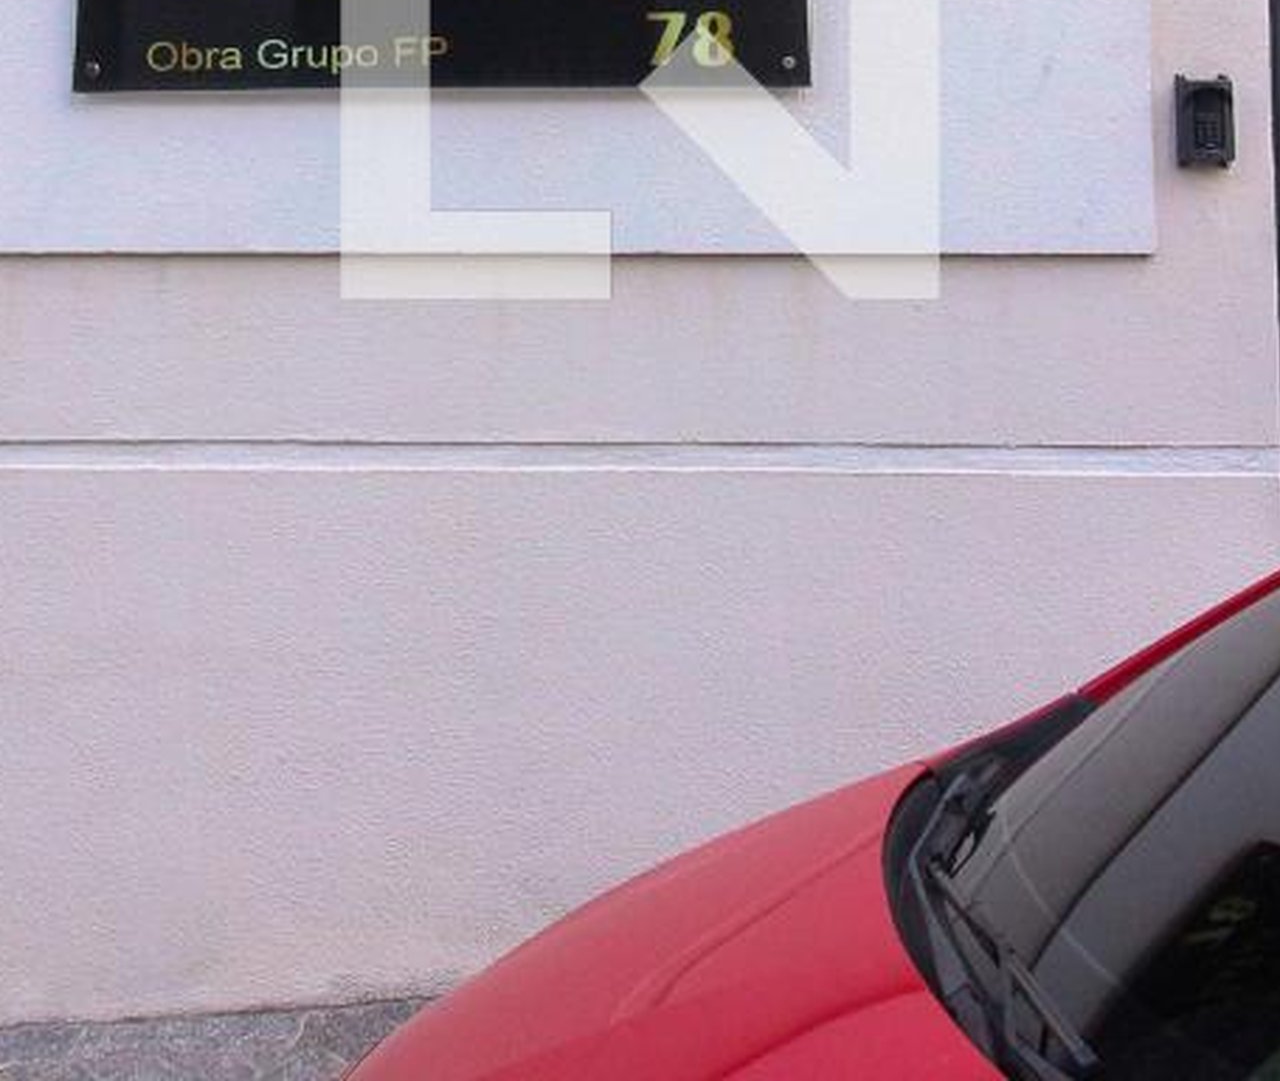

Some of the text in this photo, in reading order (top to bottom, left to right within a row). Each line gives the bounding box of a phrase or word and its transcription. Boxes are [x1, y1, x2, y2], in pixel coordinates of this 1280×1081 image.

[146, 35, 448, 75] Obra Grupo FP
[646, 10, 735, 67] 78
